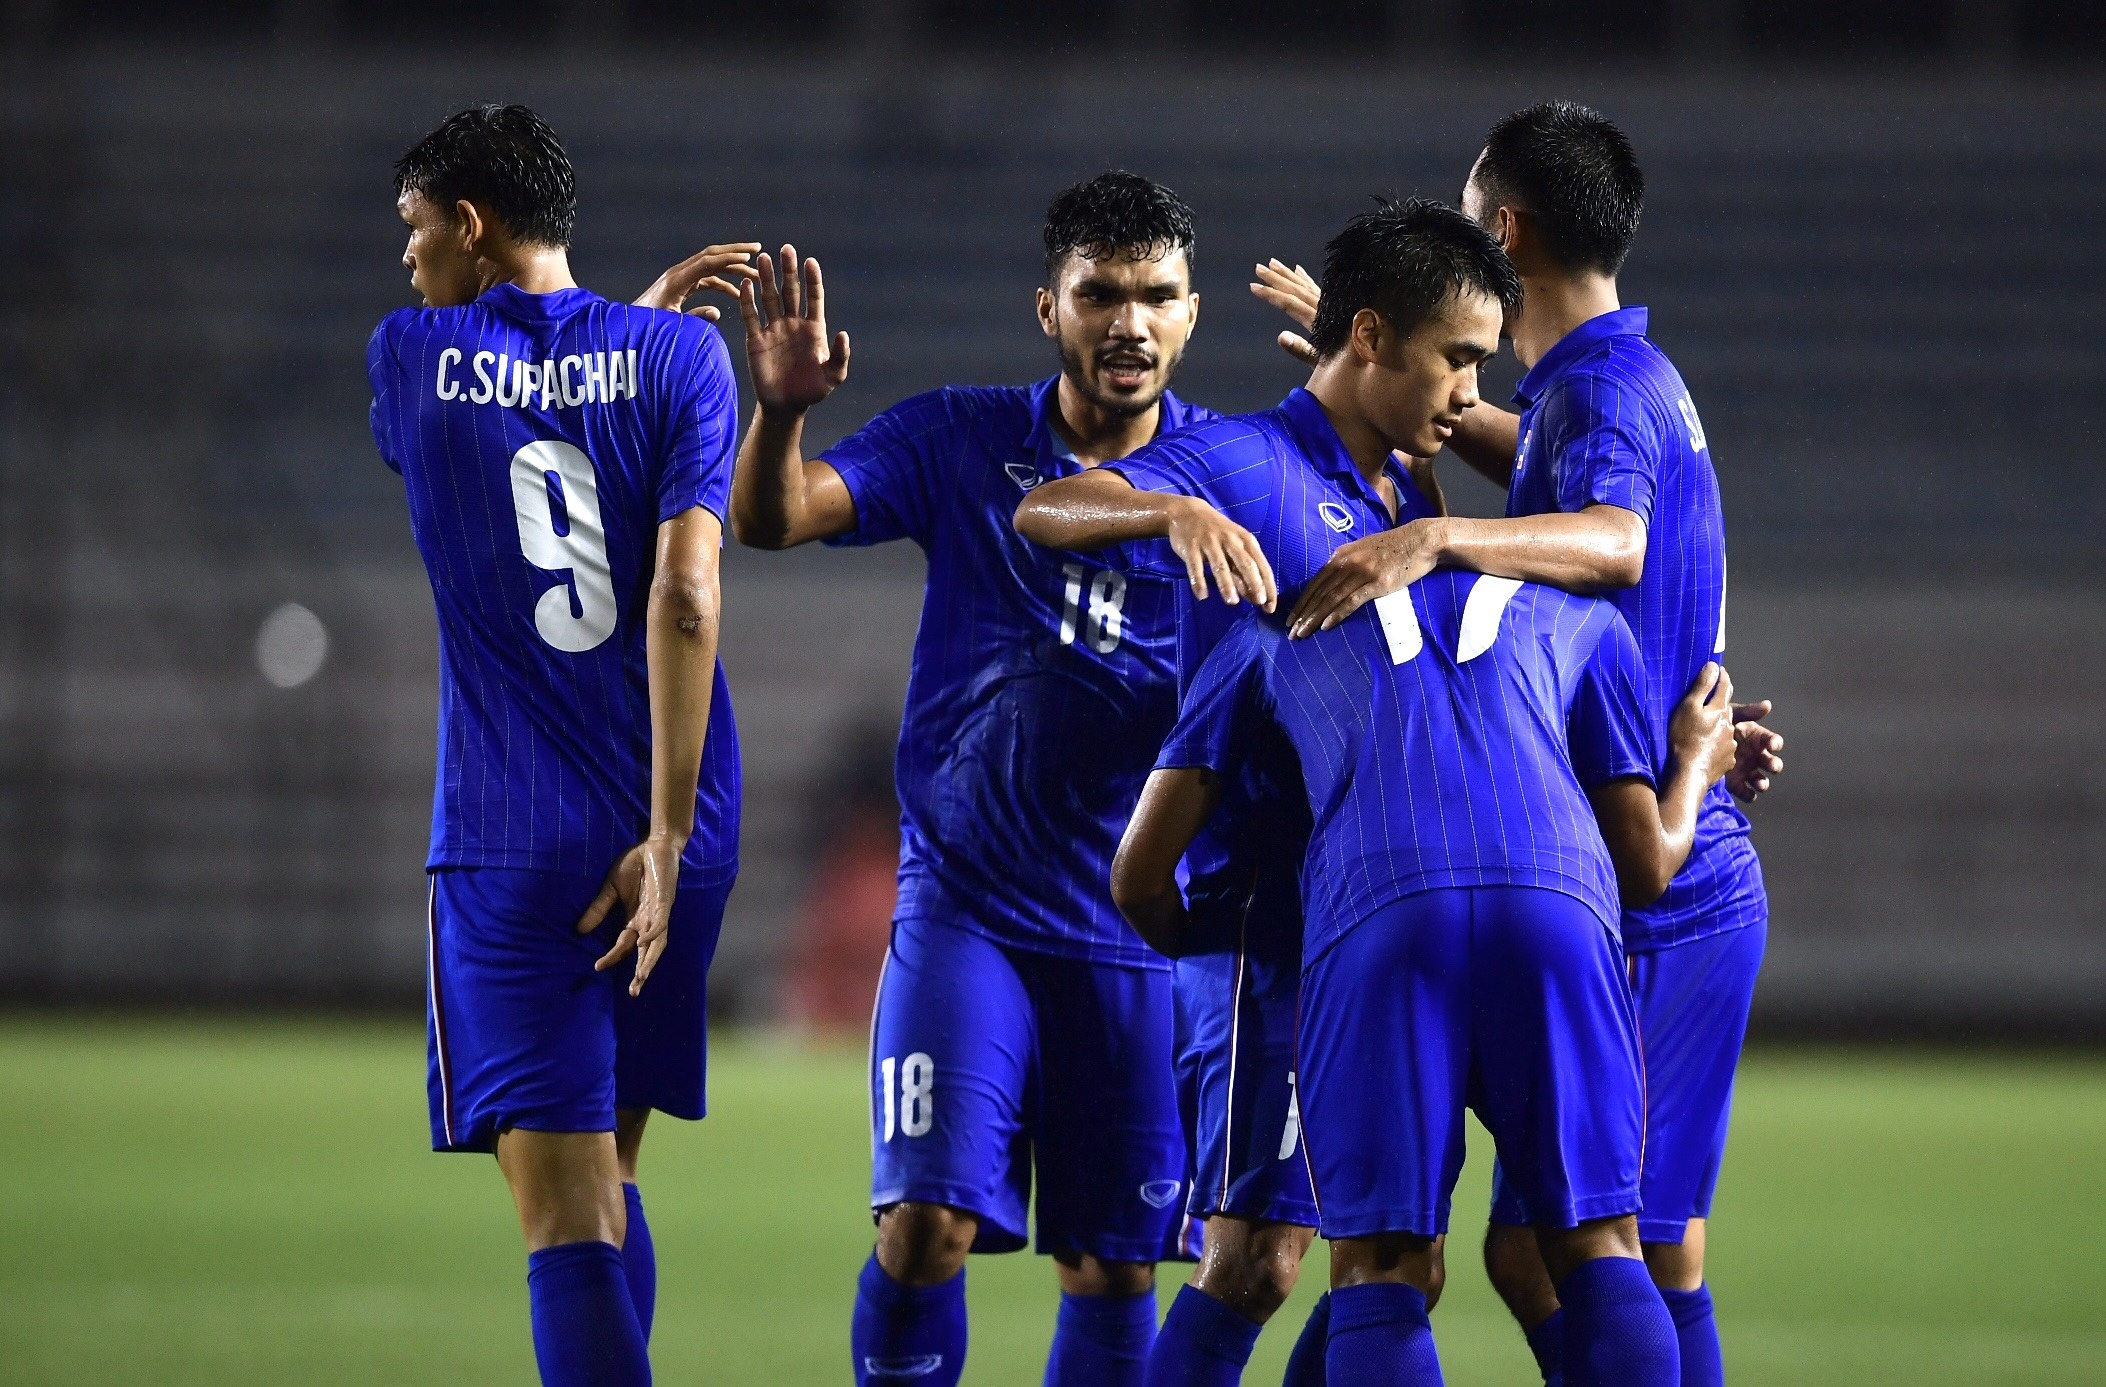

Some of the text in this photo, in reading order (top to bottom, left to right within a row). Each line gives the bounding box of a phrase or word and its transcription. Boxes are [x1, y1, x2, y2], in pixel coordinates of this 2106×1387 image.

[436, 347, 638, 410] C.SUPACHAI
[510, 440, 618, 653] 9
[1059, 563, 1127, 654] 18
[881, 1052, 934, 1144] 18
